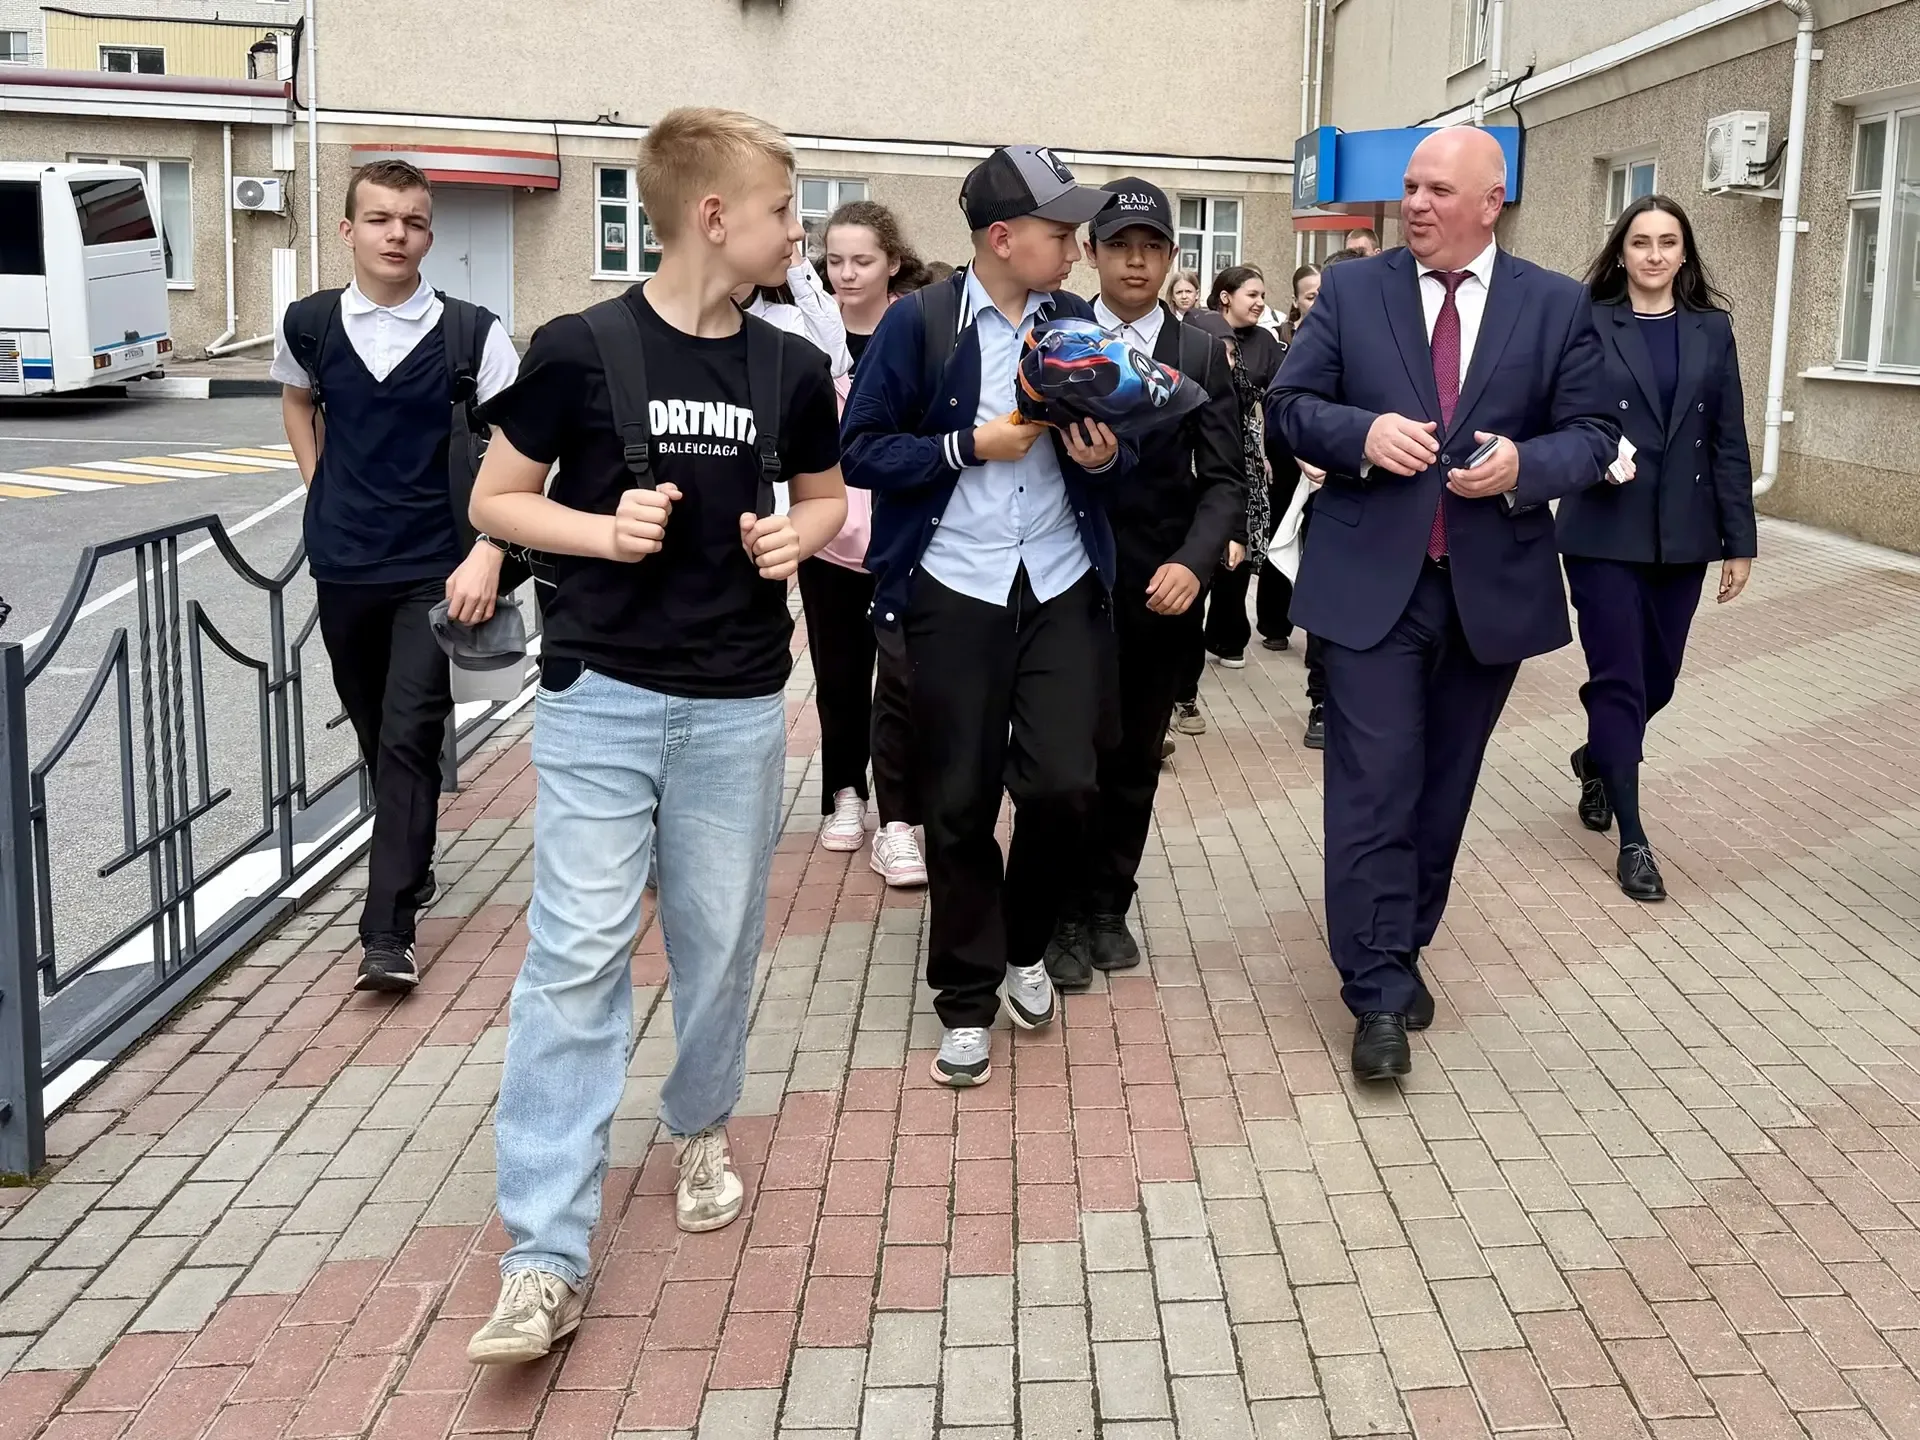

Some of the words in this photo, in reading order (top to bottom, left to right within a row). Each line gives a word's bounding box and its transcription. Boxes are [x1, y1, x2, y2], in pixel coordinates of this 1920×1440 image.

[1118, 193, 1157, 208] RADA
[1120, 204, 1149, 212] MILANO
[648, 399, 757, 446] ORTNIT
[659, 442, 738, 456] BALENCIAGA
